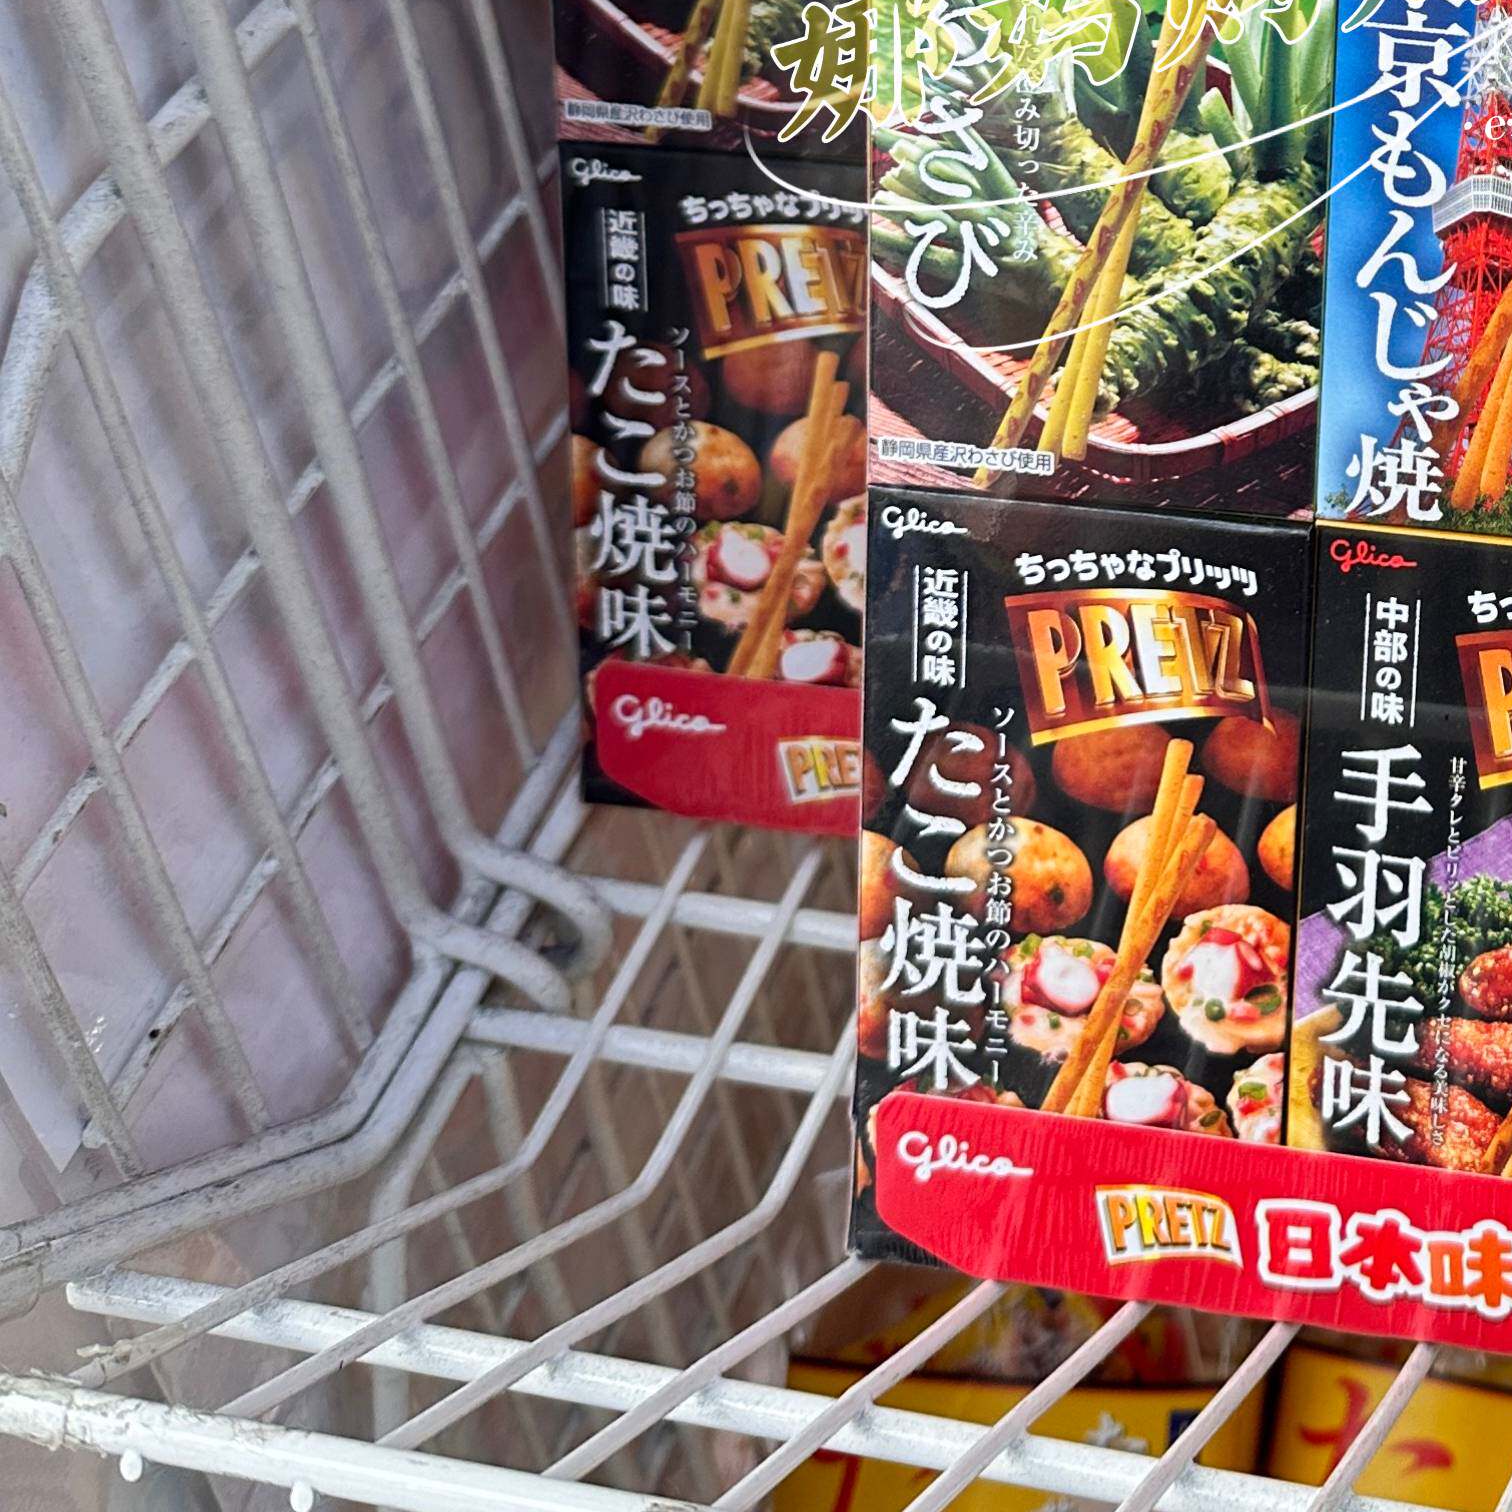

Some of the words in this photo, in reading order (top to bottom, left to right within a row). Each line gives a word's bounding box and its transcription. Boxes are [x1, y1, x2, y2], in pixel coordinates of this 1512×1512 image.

[588, 320, 681, 660] たこ焼味
[881, 506, 969, 538] Glico
[1014, 549, 1258, 596] ちっちゃなプリッツ
[1330, 540, 1418, 572] Glico
[921, 566, 960, 688] 近畿の味
[1028, 603, 1256, 716] PRETZ
[1369, 596, 1409, 726] 中部の味
[614, 694, 728, 739] Glico
[880, 697, 987, 1090] たこ焼味
[1320, 743, 1434, 1147] 手羽先味
[897, 1130, 1035, 1180] Glico
[1105, 1193, 1233, 1252] PRETZ
